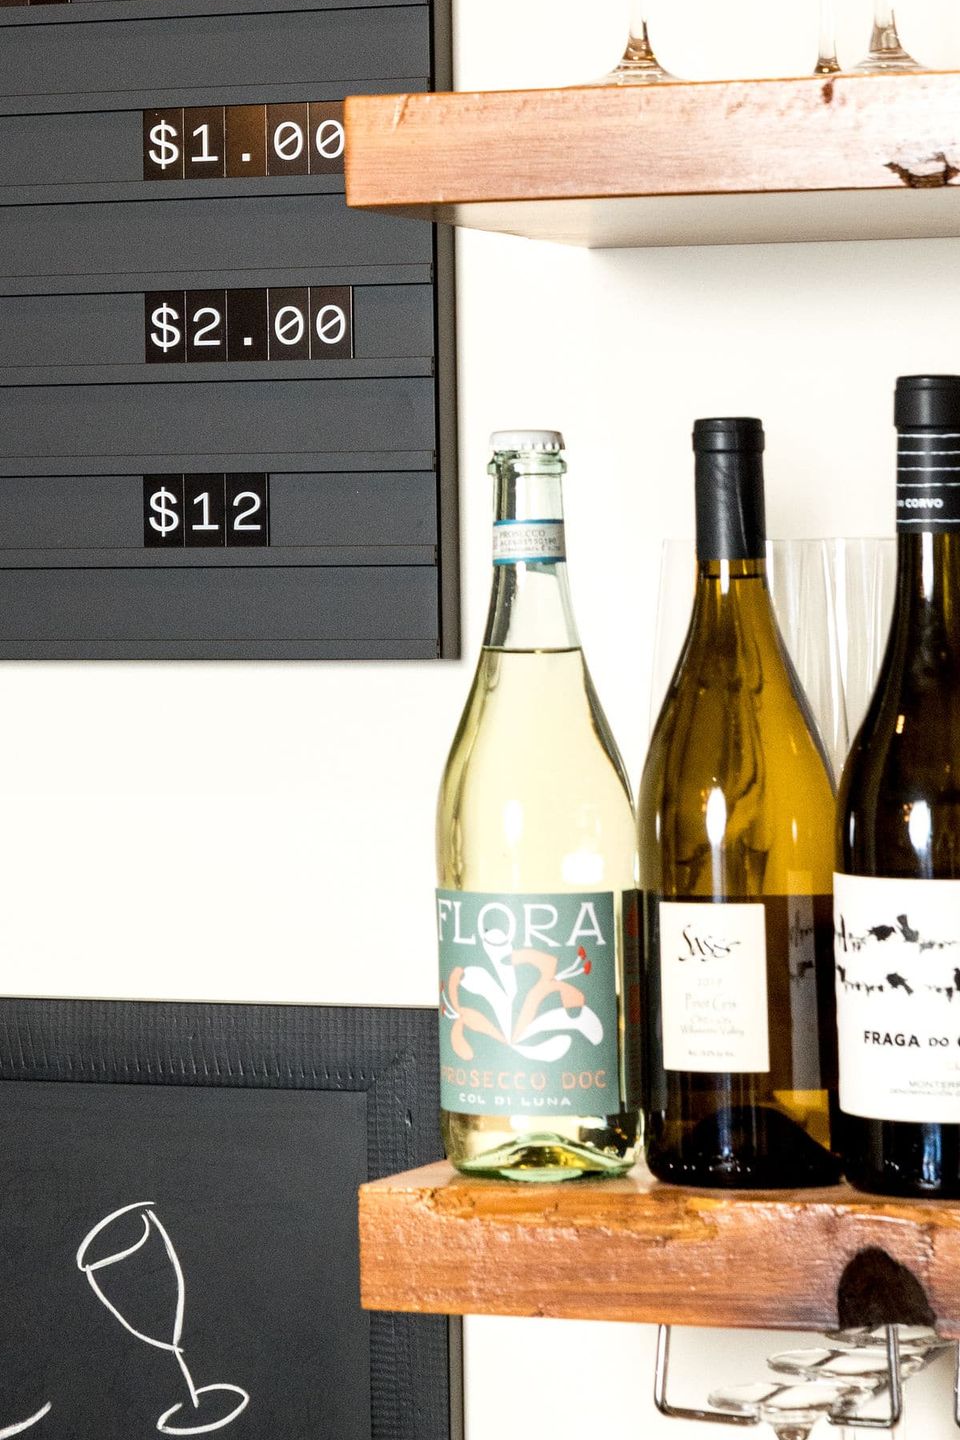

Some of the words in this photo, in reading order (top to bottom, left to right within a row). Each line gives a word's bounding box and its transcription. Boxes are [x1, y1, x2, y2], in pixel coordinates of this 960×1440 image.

[148, 119, 344, 170] $1.00
[150, 302, 347, 353] $2.00
[148, 486, 261, 538] $12
[905, 498, 944, 509] CORVO
[437, 898, 607, 947] FLORA
[863, 1030, 921, 1048] FRAGA
[441, 1066, 546, 1091] PROSECCO
[561, 1069, 608, 1090] DOC
[458, 1092, 486, 1105] COL
[494, 1095, 512, 1106] DI
[520, 1095, 572, 1107] LUNA
